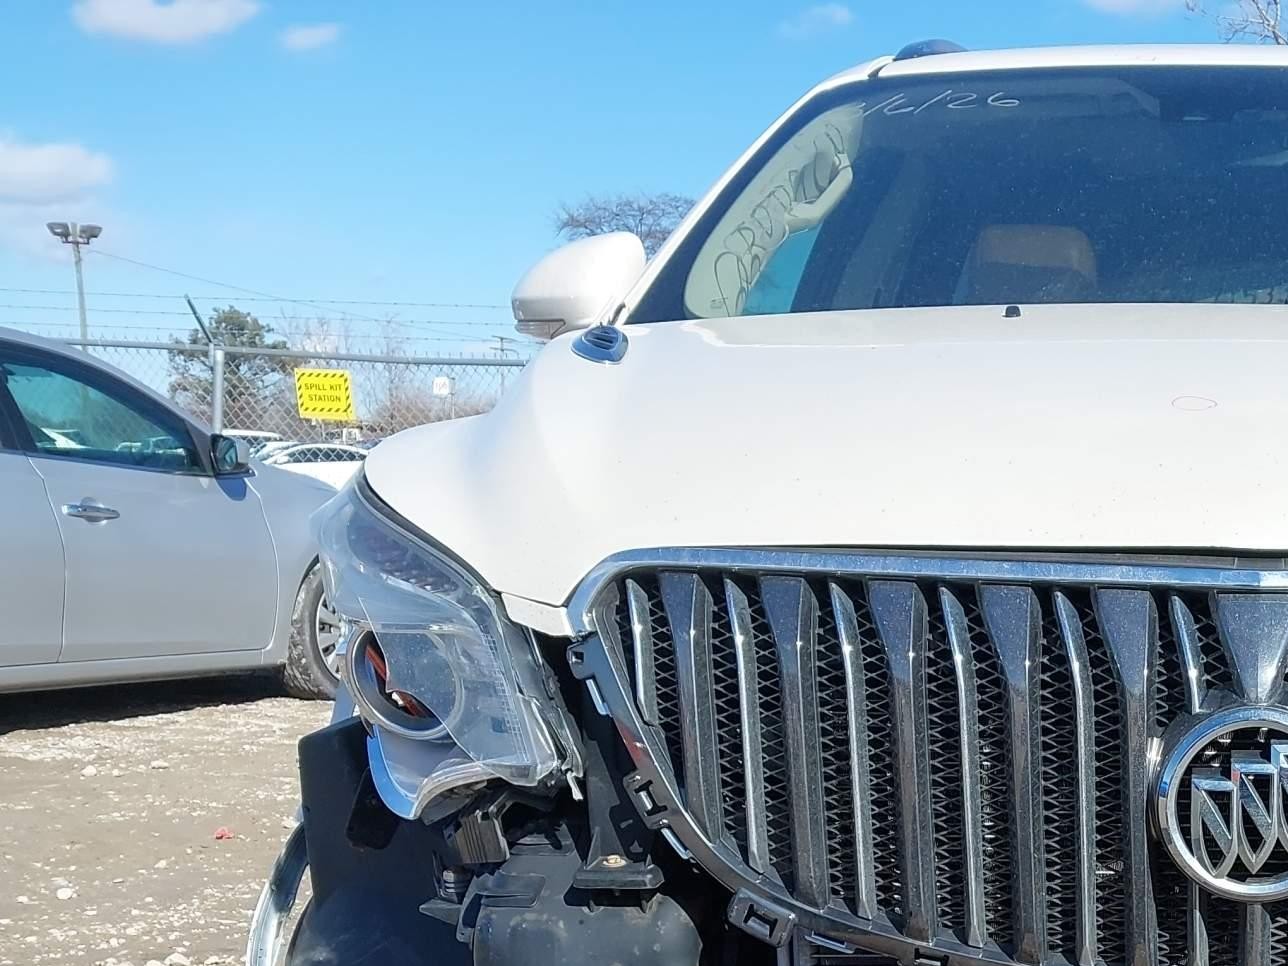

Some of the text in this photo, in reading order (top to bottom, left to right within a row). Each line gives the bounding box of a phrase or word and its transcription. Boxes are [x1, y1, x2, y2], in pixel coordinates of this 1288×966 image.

[304, 382, 342, 391] SPILL KIT
[308, 394, 341, 402] STATION
